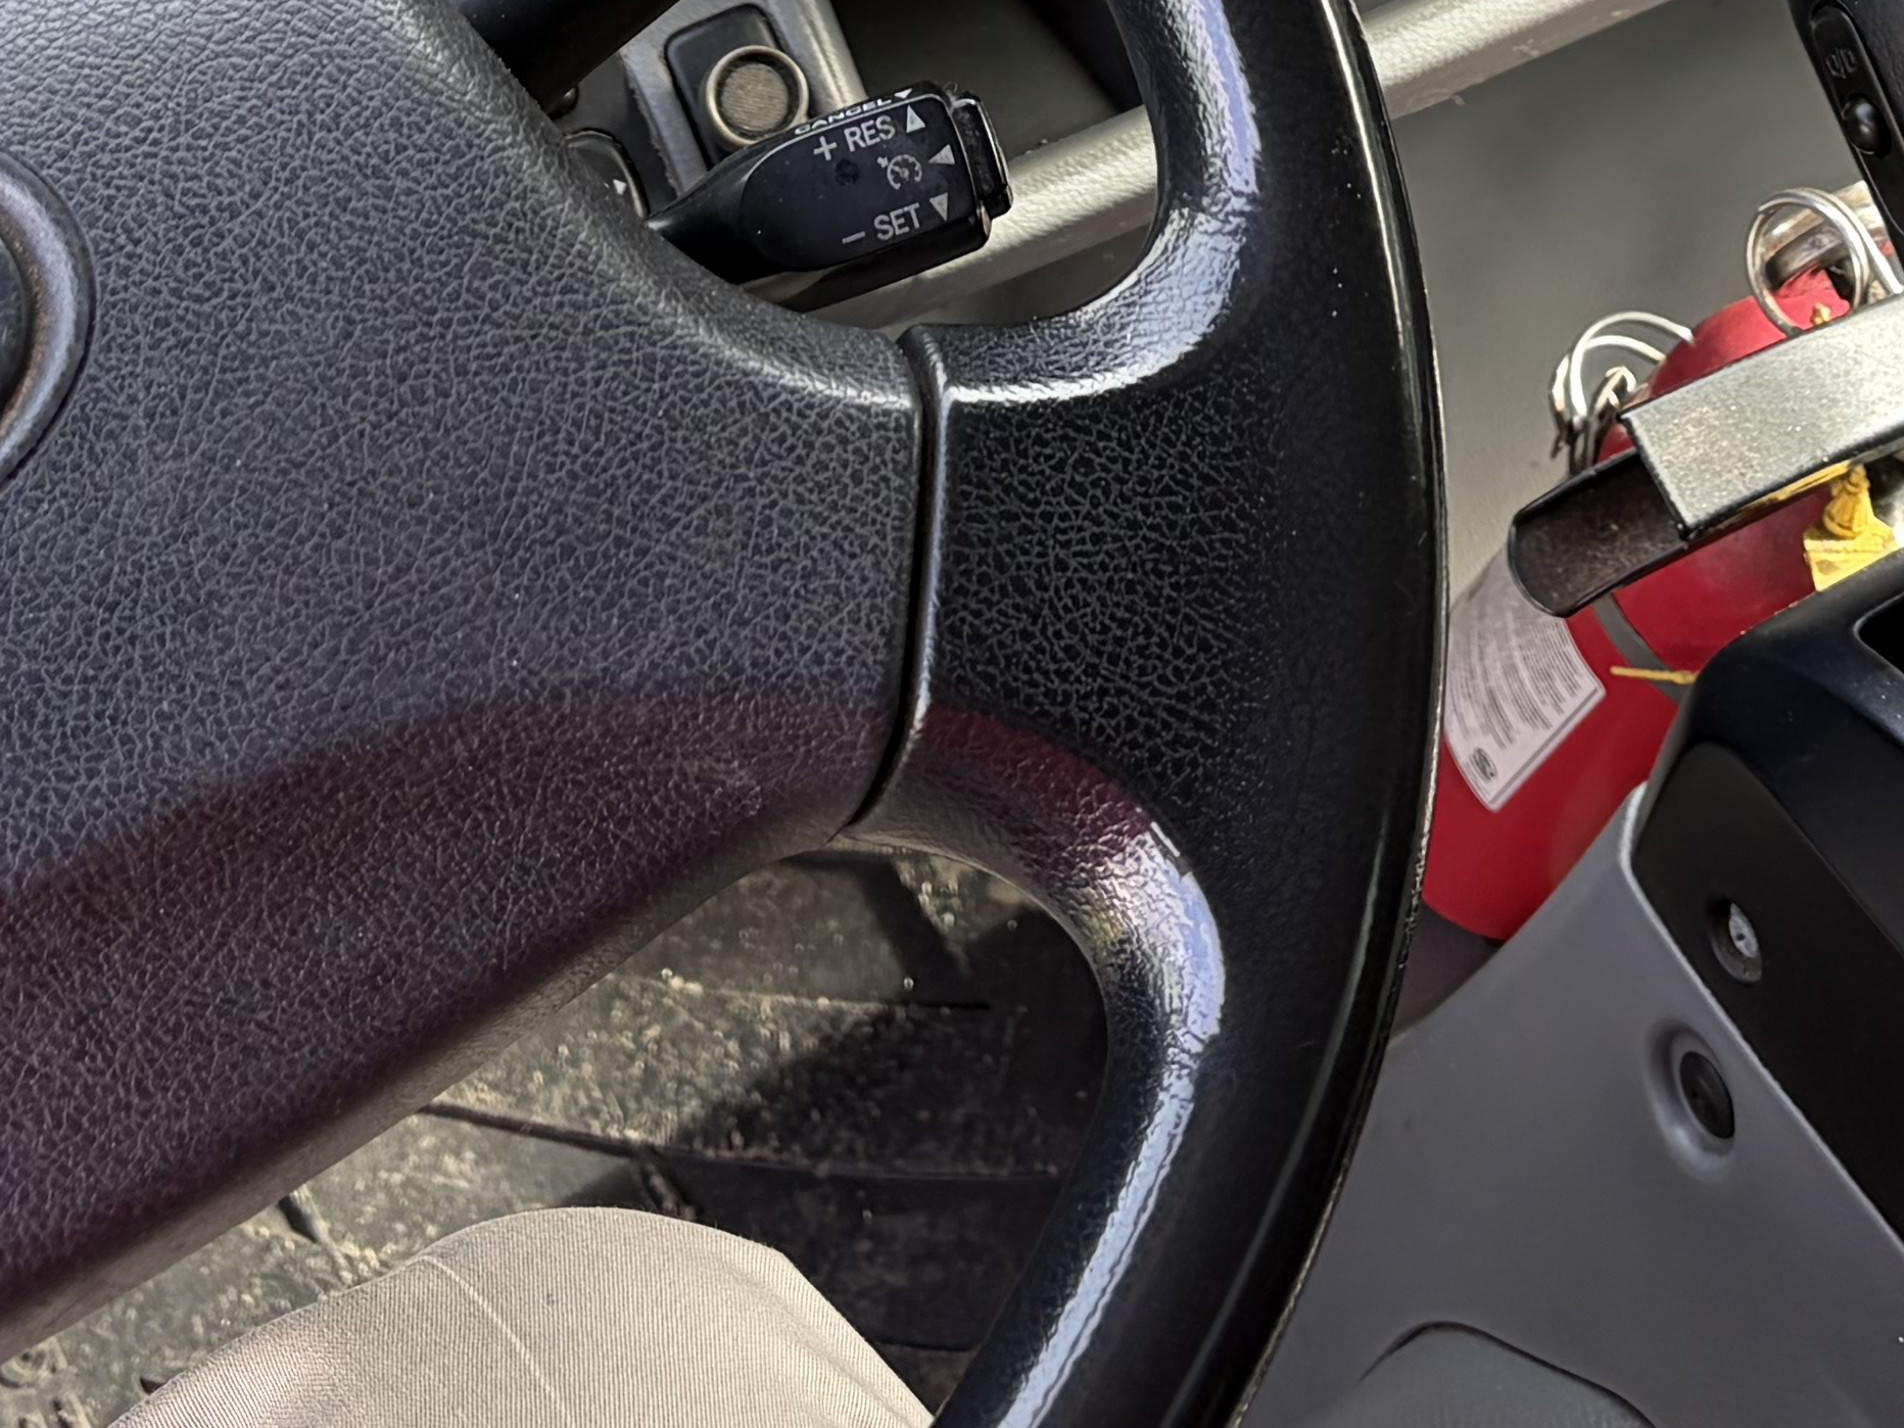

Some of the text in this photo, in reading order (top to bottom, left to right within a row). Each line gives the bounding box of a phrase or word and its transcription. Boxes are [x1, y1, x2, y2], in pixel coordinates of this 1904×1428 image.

[795, 96, 894, 135] CANCEL
[846, 117, 896, 152] RES
[873, 204, 921, 241] SET
